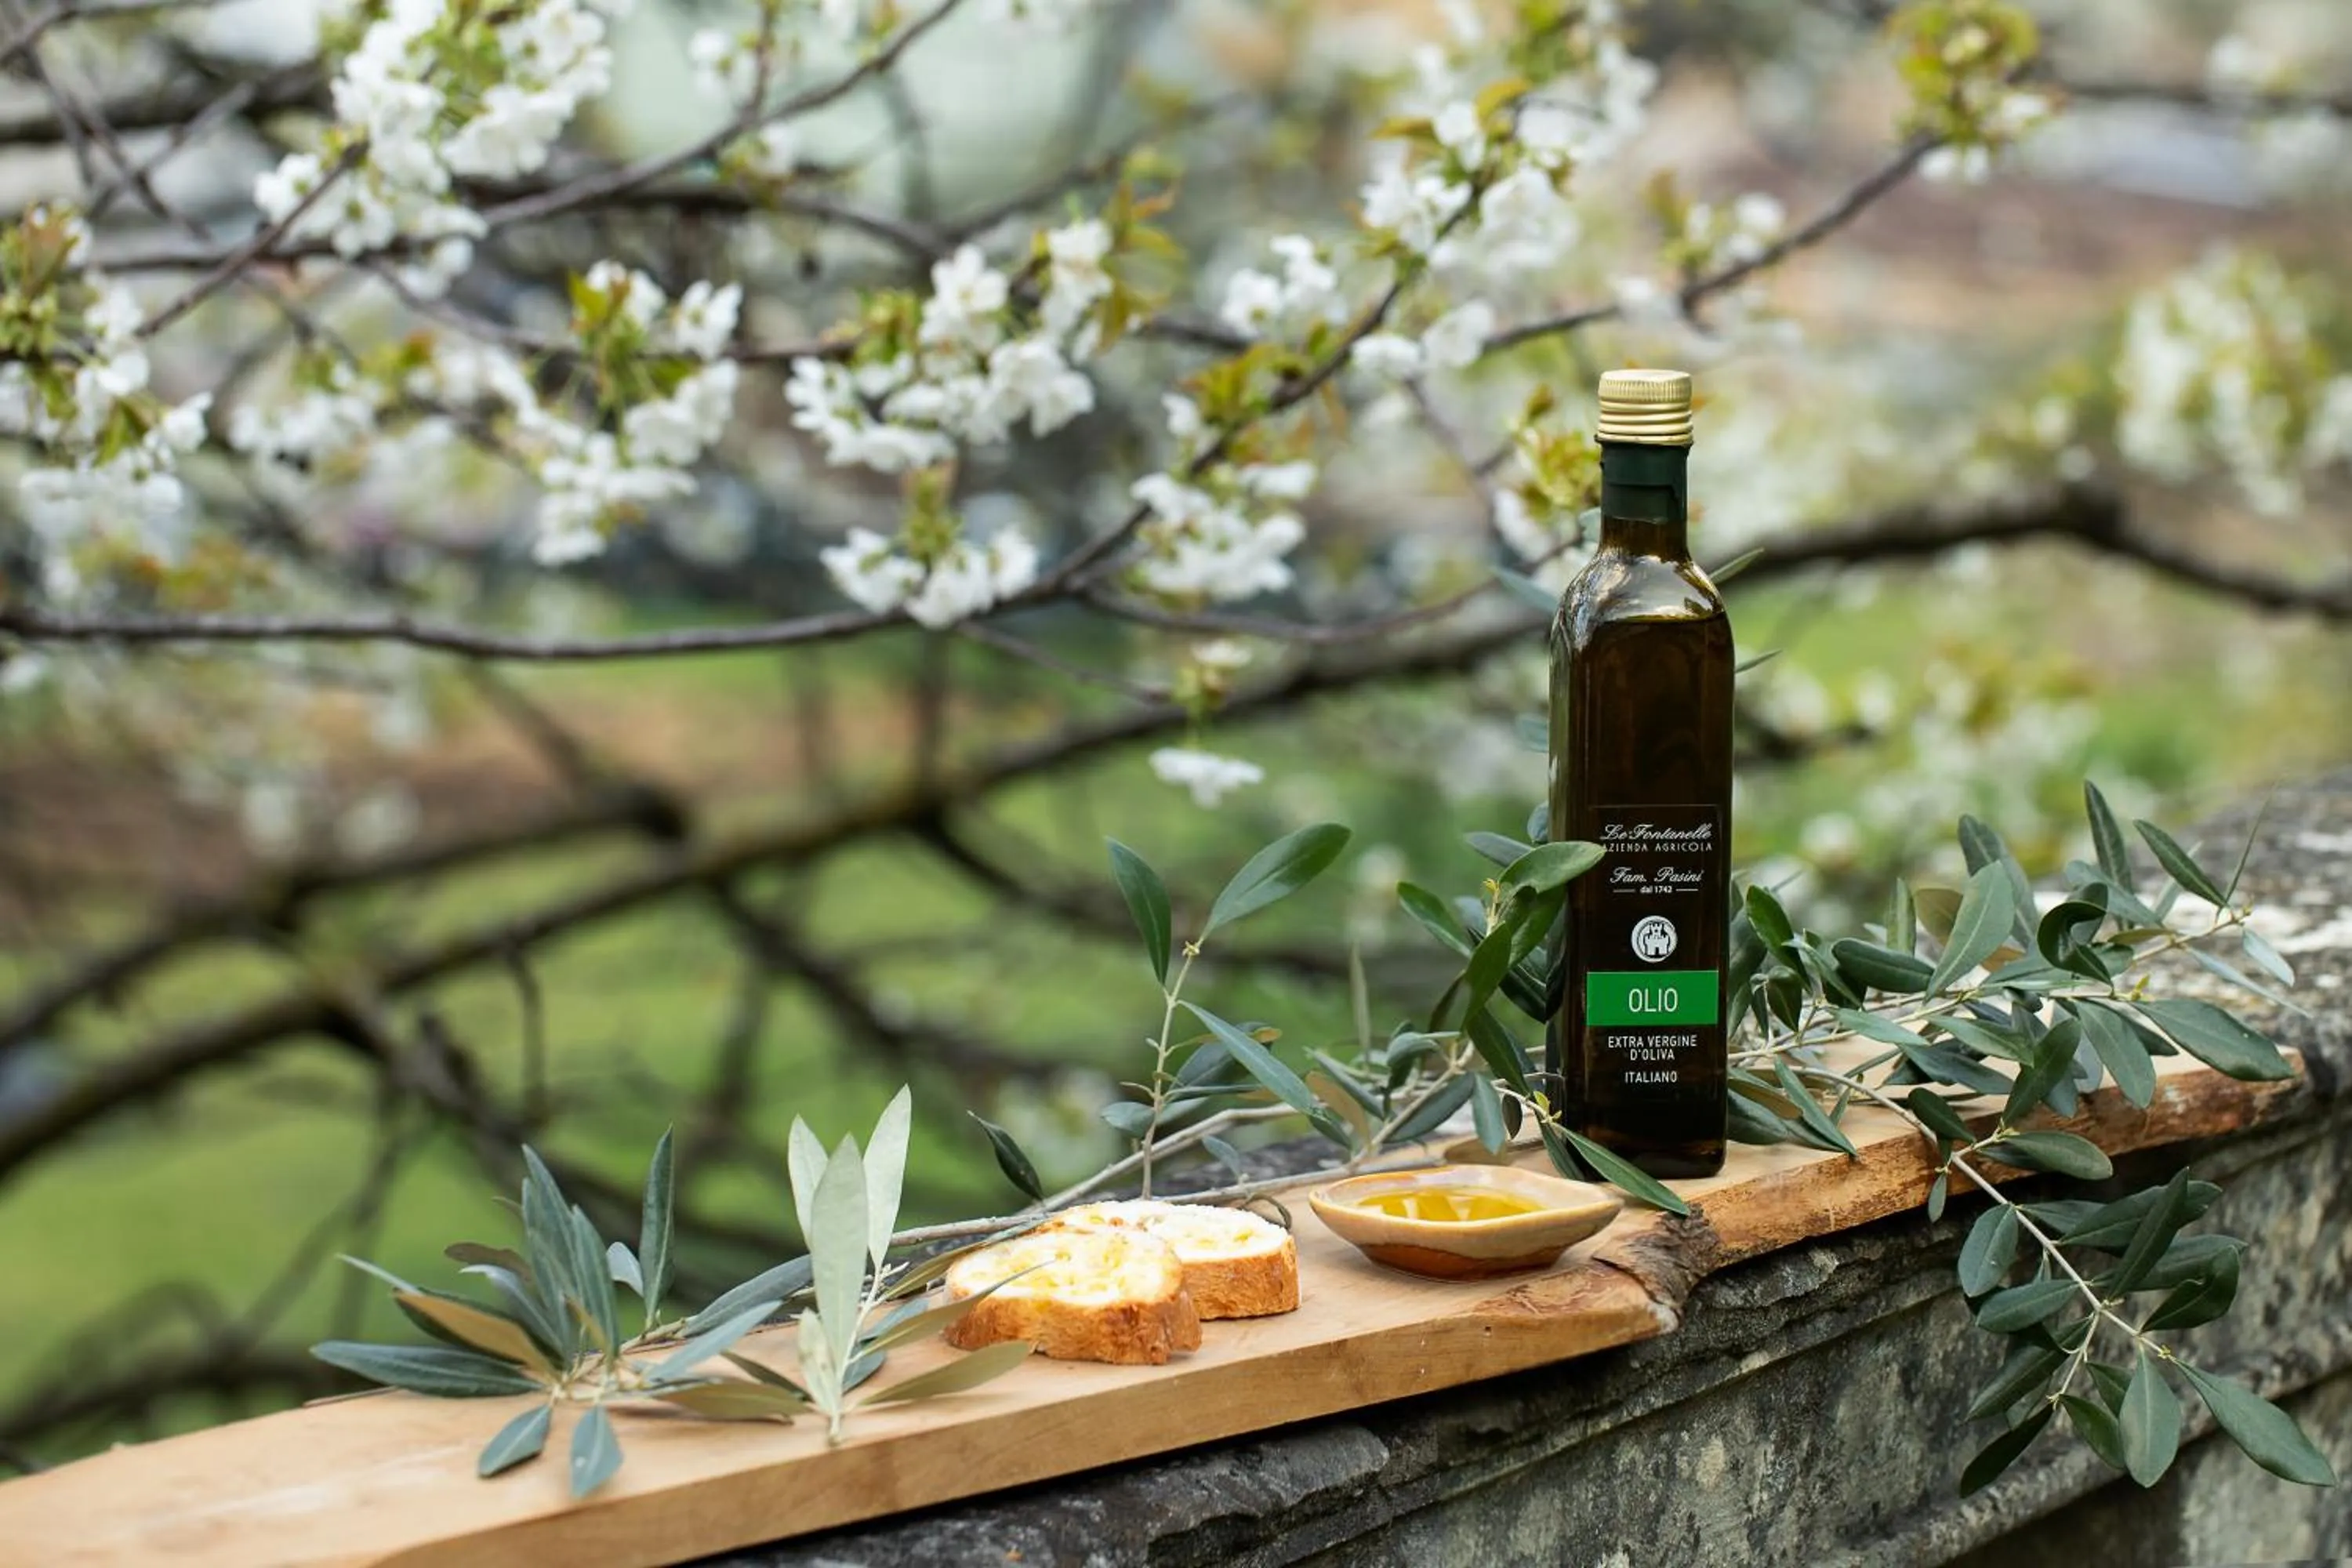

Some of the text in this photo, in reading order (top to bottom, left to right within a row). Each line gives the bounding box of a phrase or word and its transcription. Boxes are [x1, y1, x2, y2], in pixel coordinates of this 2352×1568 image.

[1600, 823, 1712, 840] Le Fontanelle
[1655, 842, 1712, 852] AGRICOLA
[1610, 866, 1704, 884] Fam. Pasini
[1655, 885, 1673, 894] 1742
[1628, 988, 1679, 1012] OLIO
[1608, 1034, 1697, 1048] EXTRA VERGINE
[1630, 1048, 1675, 1061] D'OLIVA
[1624, 1070, 1678, 1083] ITALIANO
